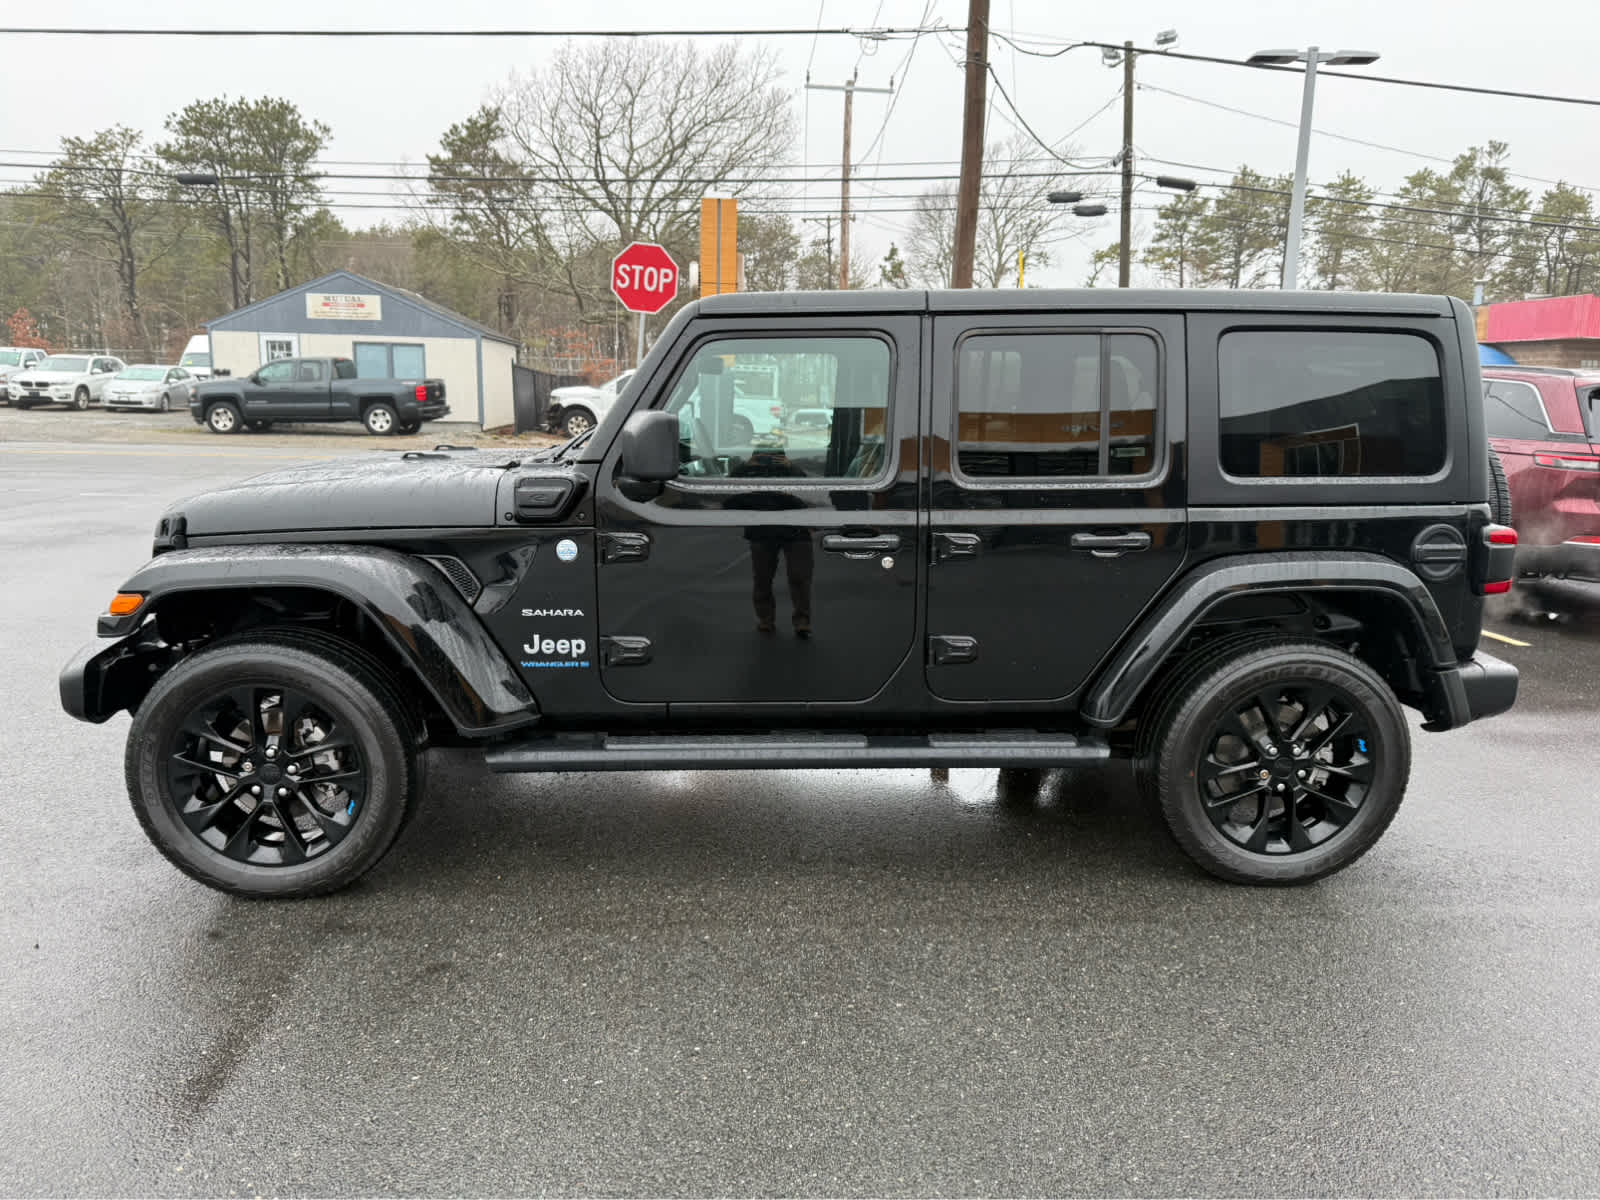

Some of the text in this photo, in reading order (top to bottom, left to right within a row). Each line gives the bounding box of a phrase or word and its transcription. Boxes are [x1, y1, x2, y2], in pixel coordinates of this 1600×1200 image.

[616, 263, 674, 293] STOP
[521, 608, 585, 617] SAHARA
[523, 633, 587, 658] Jeep
